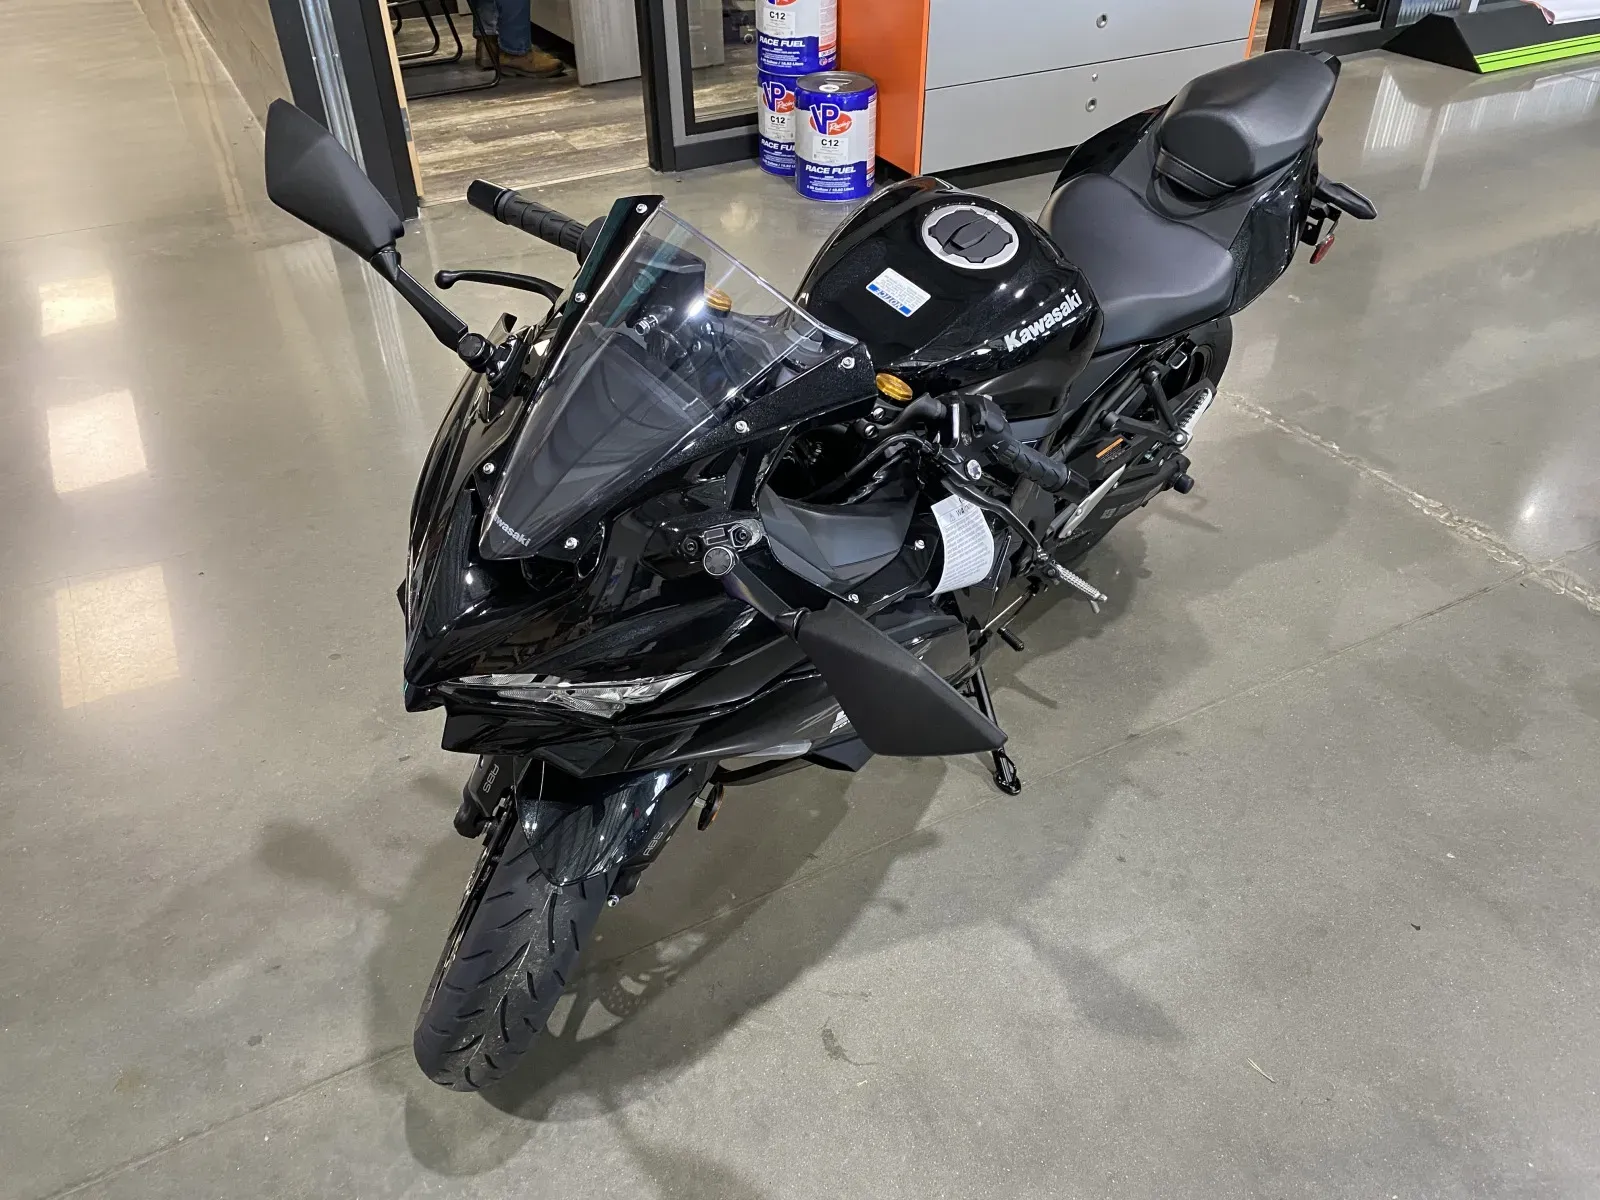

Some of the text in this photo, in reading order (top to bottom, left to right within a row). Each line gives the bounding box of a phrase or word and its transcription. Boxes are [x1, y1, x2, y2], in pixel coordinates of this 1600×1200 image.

[769, 11, 786, 20] C12
[760, 36, 779, 46] RACE
[762, 81, 787, 112] VP
[770, 115, 786, 124] C12
[809, 103, 841, 135] VP
[829, 120, 852, 132] Racing
[761, 139, 779, 150] RACE
[821, 138, 839, 147] C12
[805, 164, 830, 174] RACE
[831, 166, 856, 174] FUEL
[1003, 288, 1083, 353] Kawasaki
[482, 763, 500, 793] ABS
[642, 831, 664, 856] ABS
